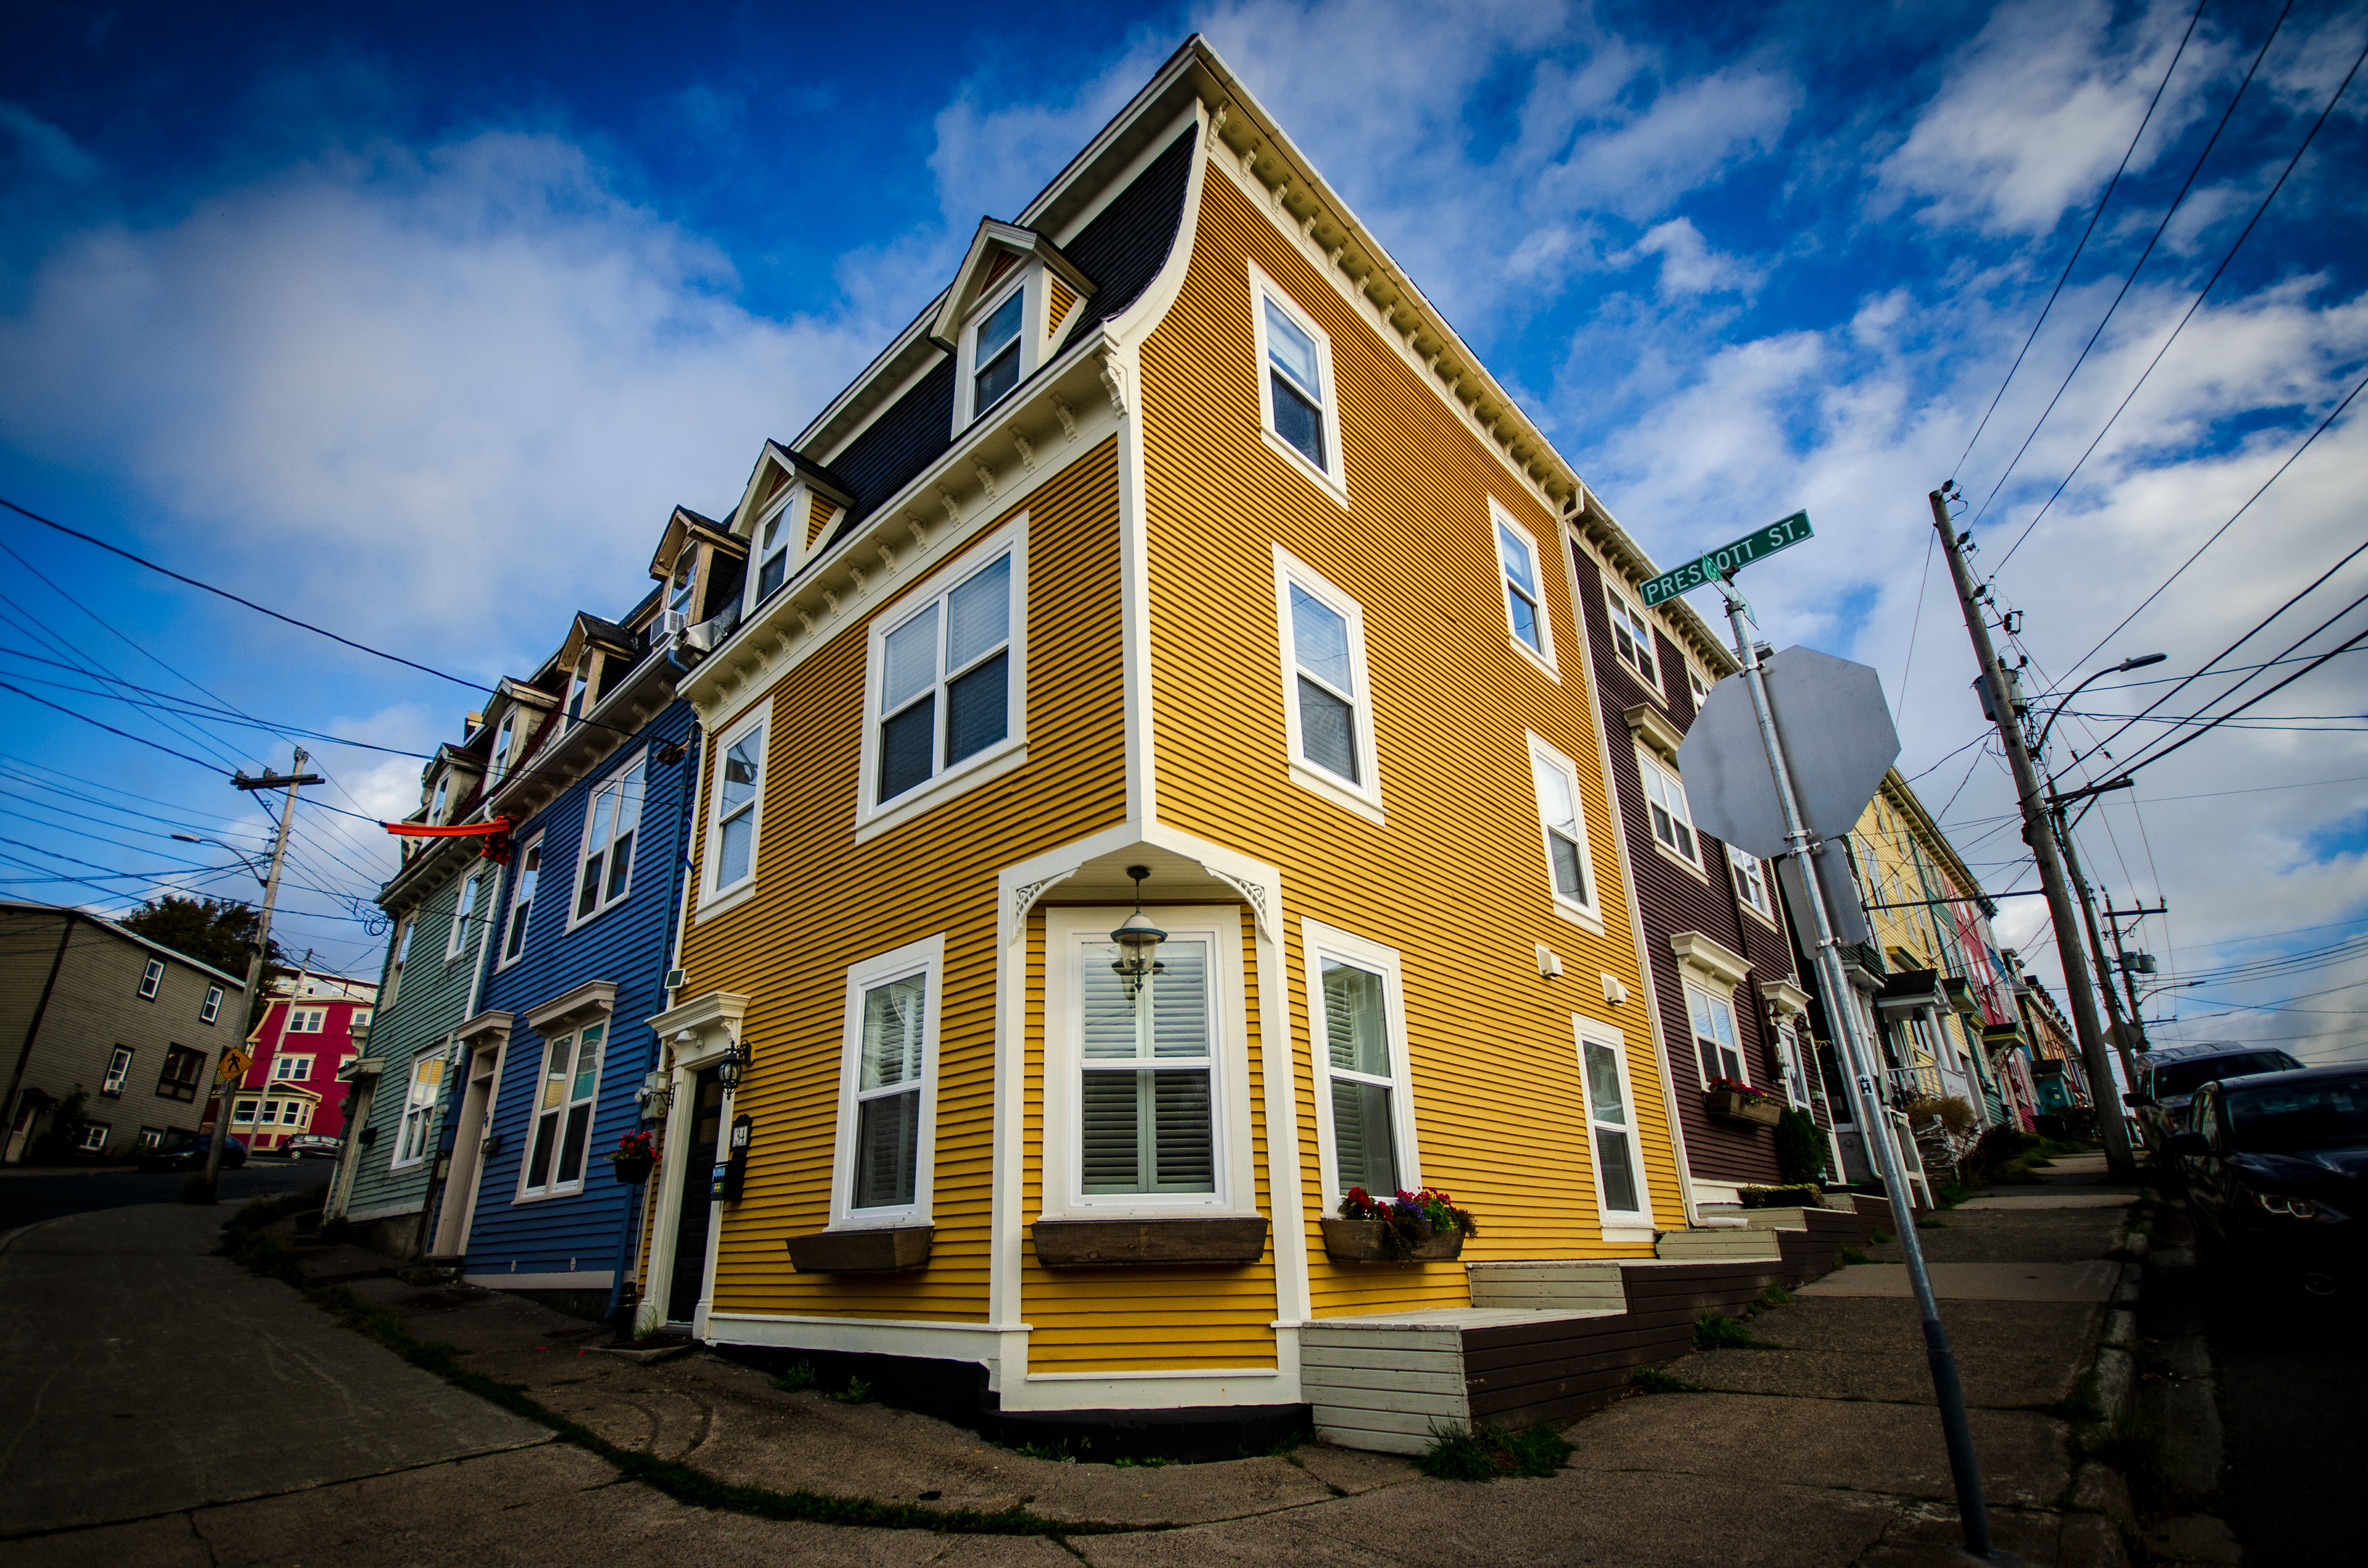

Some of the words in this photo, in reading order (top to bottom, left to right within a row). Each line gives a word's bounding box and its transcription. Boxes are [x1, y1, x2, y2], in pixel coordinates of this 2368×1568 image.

[1769, 520, 1806, 546] ST.
[1860, 1082, 1873, 1094] H
[735, 1128, 745, 1144] 34
